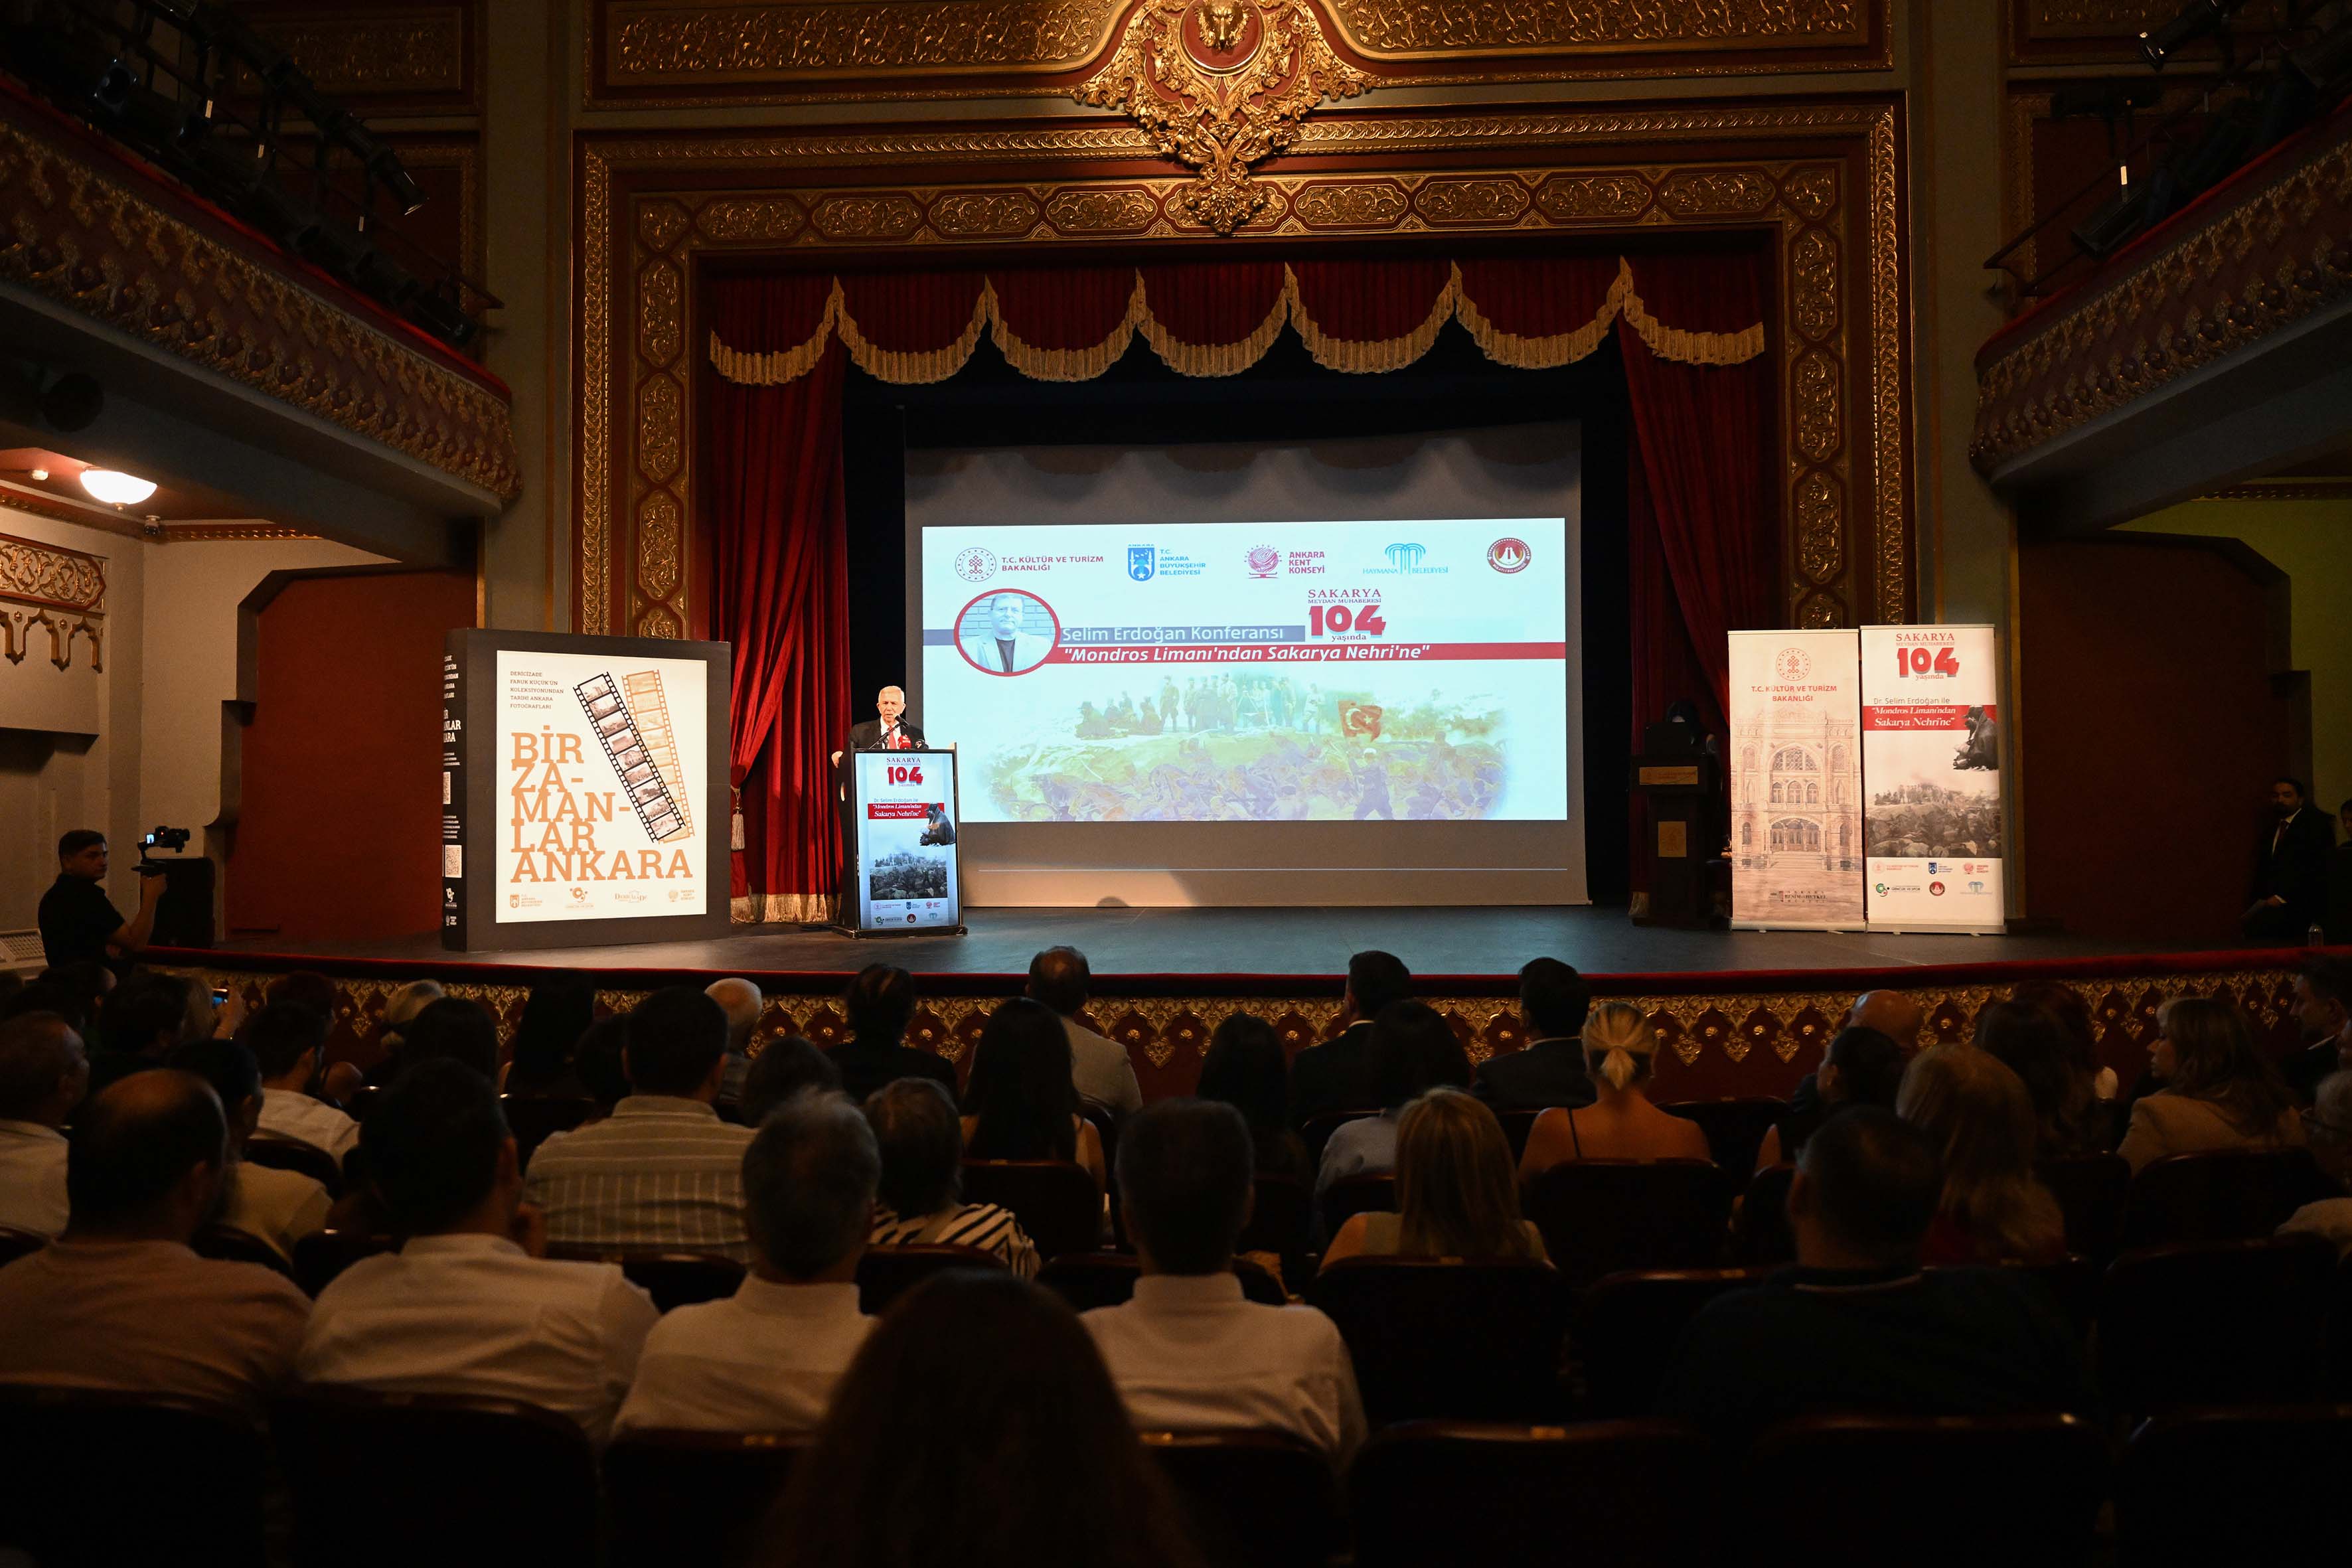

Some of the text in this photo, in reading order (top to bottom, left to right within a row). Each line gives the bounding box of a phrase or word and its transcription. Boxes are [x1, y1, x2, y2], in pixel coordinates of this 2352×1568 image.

[1289, 565, 1325, 574] KONSEYİ
[1308, 589, 1381, 598] SAKARYA
[1308, 605, 1387, 637] 104
[1063, 625, 1284, 643] Selim Erdoğan Konferansı
[1332, 633, 1367, 642] yaşında
[1895, 633, 1955, 641] SAKARYA
[1065, 644, 1431, 662] "Mondros Limanı'ndan Sakarya Nehri'ne"
[1897, 647, 1960, 677] 104
[1874, 717, 1910, 728] Sakarya
[510, 725, 584, 763] BİR
[511, 761, 583, 793] ZA-
[887, 766, 923, 785] 104
[511, 791, 631, 823] MAN-
[510, 821, 597, 852] LAR
[510, 849, 693, 883] ANKARA
